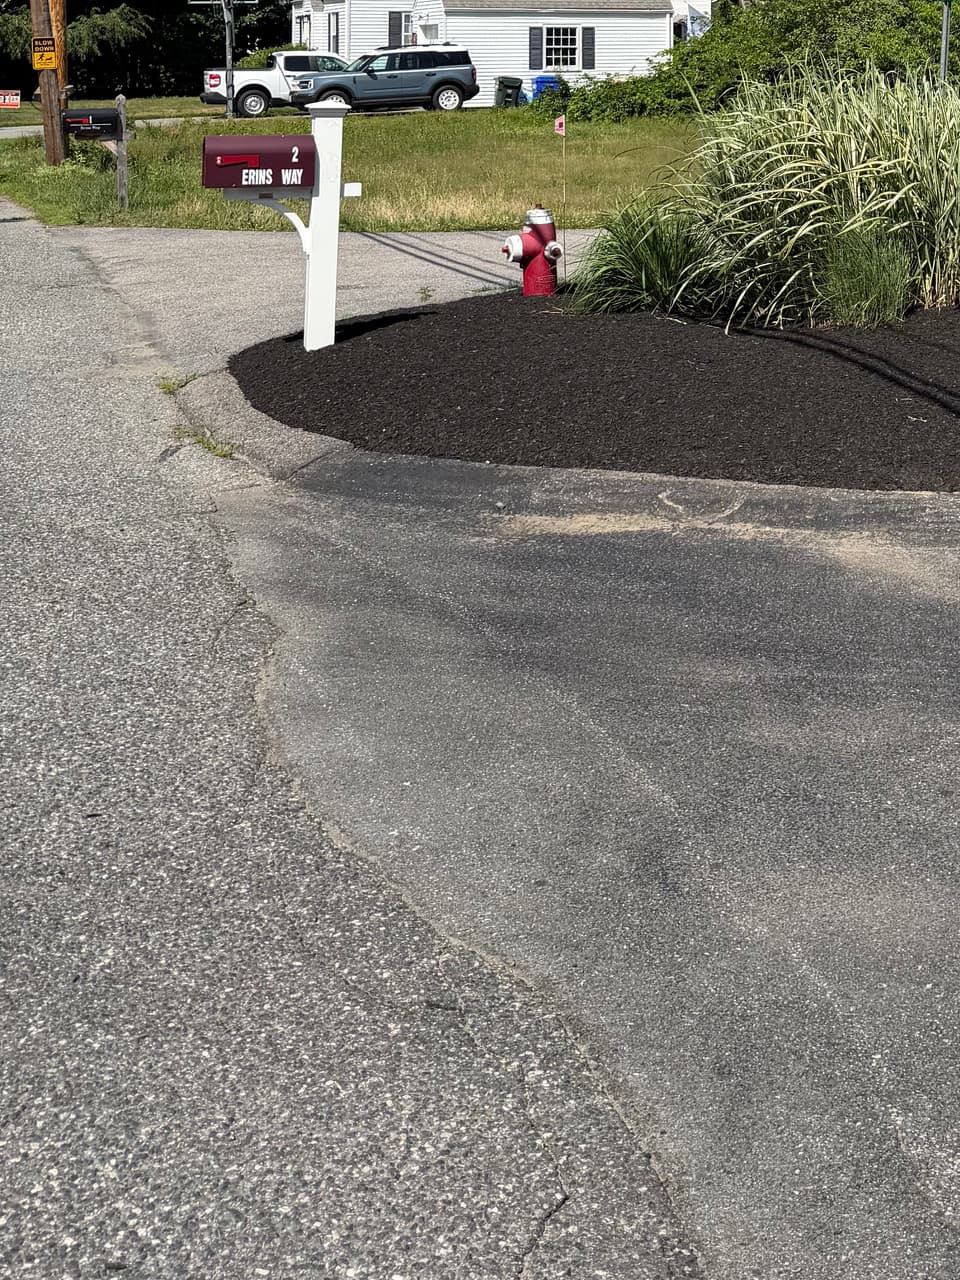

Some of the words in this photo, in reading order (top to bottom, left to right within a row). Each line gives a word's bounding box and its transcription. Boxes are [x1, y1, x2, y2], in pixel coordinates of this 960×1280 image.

[291, 146, 299, 163] 2
[242, 168, 273, 185] ERINS
[281, 168, 303, 185] WAY
